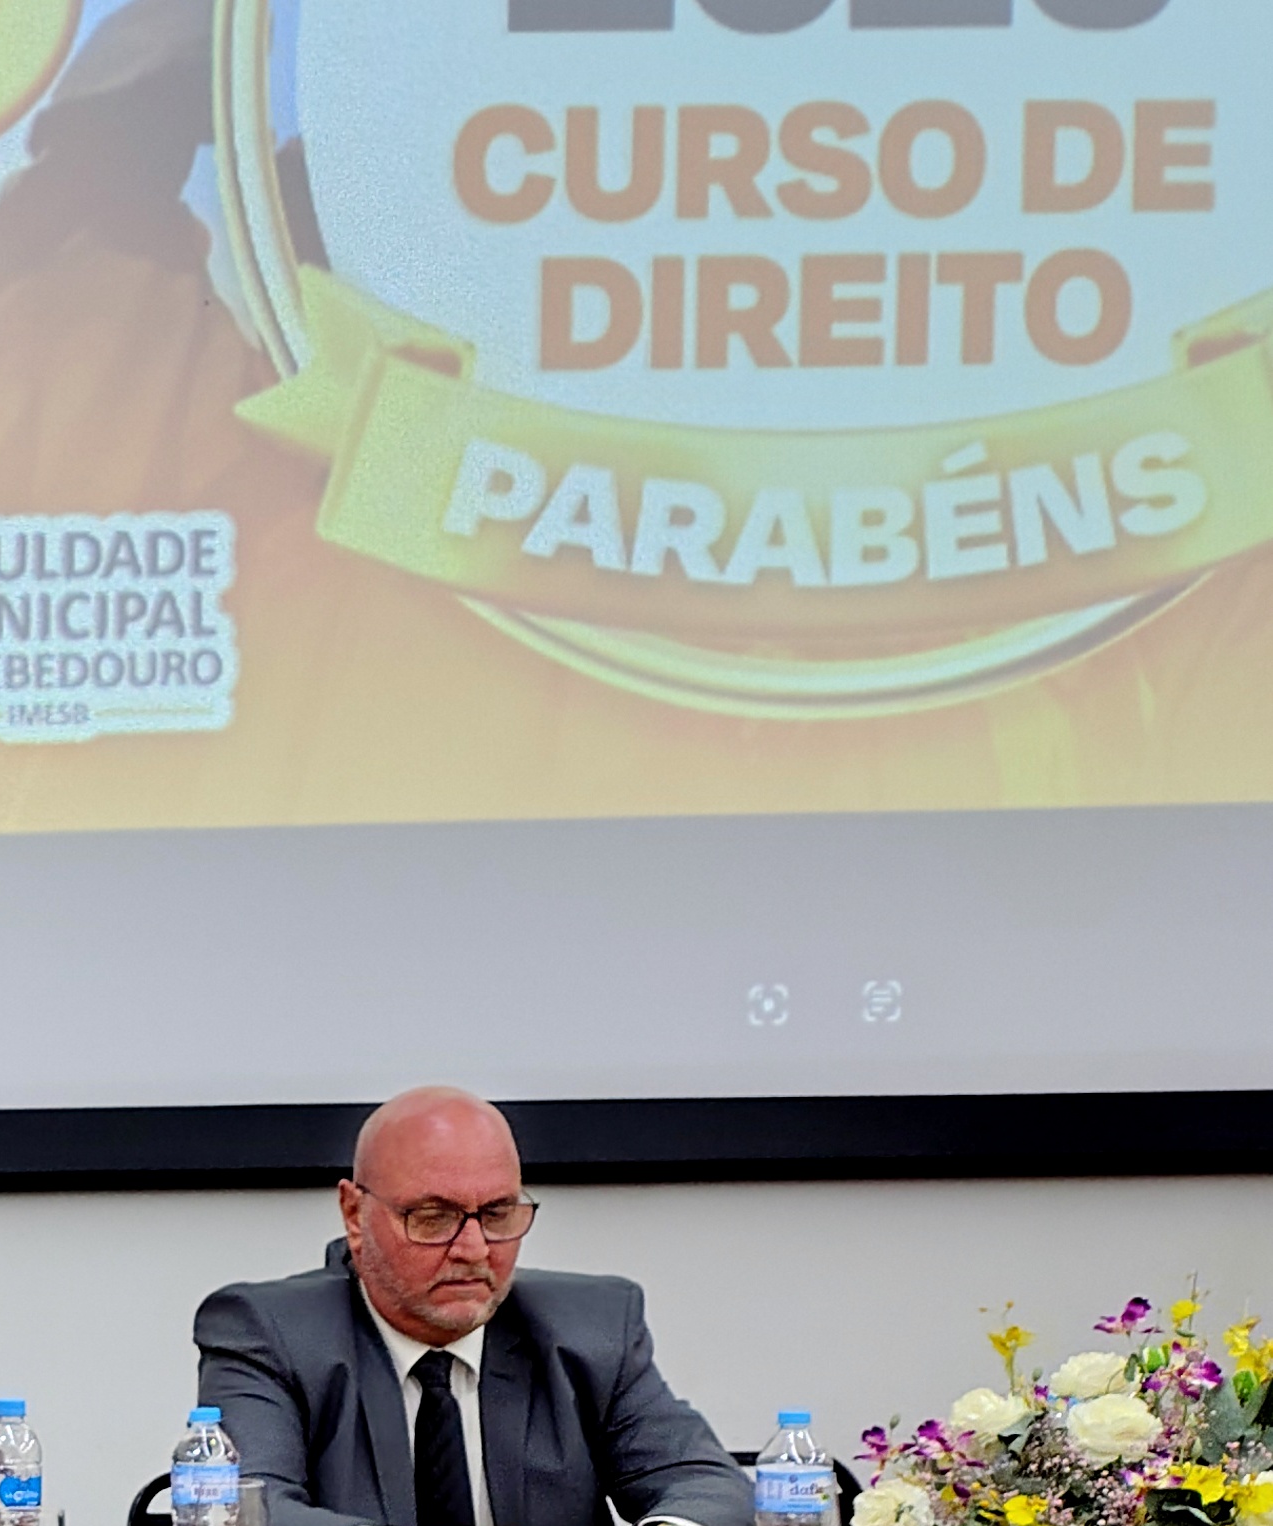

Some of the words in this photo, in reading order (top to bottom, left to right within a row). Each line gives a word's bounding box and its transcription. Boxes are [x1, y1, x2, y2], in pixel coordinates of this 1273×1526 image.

[453, 99, 988, 225] CURSO
[1021, 98, 1216, 215] DE
[537, 247, 1134, 372] DIREITO
[442, 431, 1208, 588] PARABÉNS
[7, 700, 91, 726] IMESB
